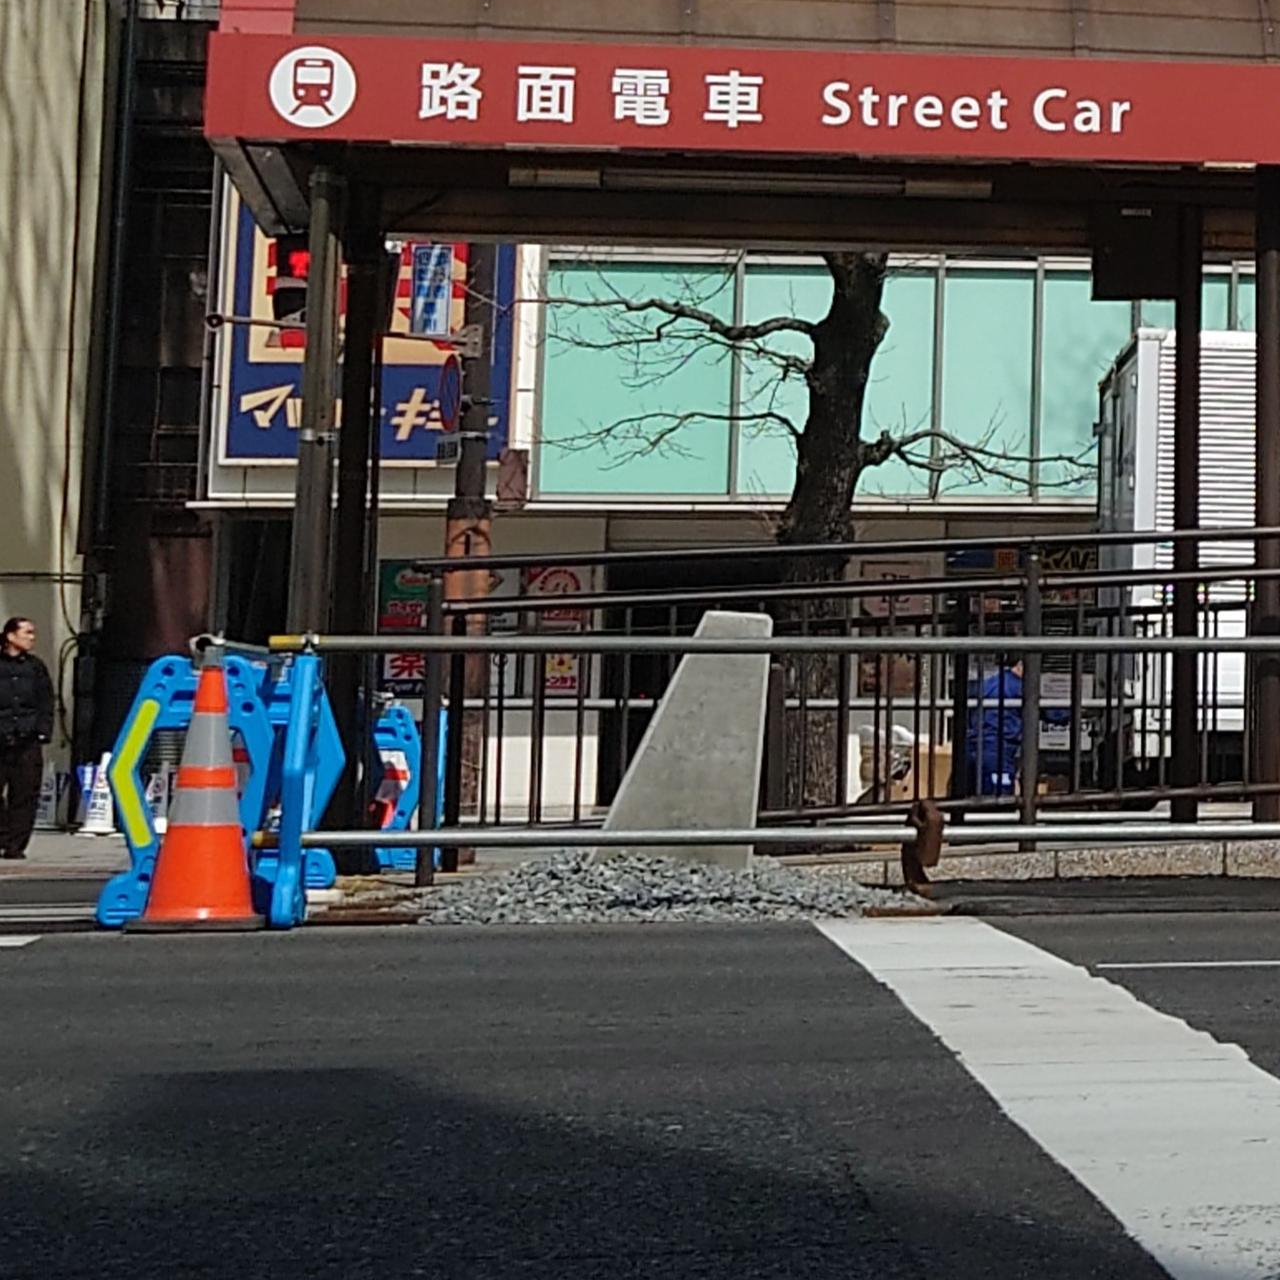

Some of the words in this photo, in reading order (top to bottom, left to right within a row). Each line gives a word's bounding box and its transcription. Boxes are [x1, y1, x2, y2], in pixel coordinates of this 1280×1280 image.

[420, 62, 764, 128] 路面電車
[821, 81, 1008, 131] Street
[1033, 89, 1132, 133] Car
